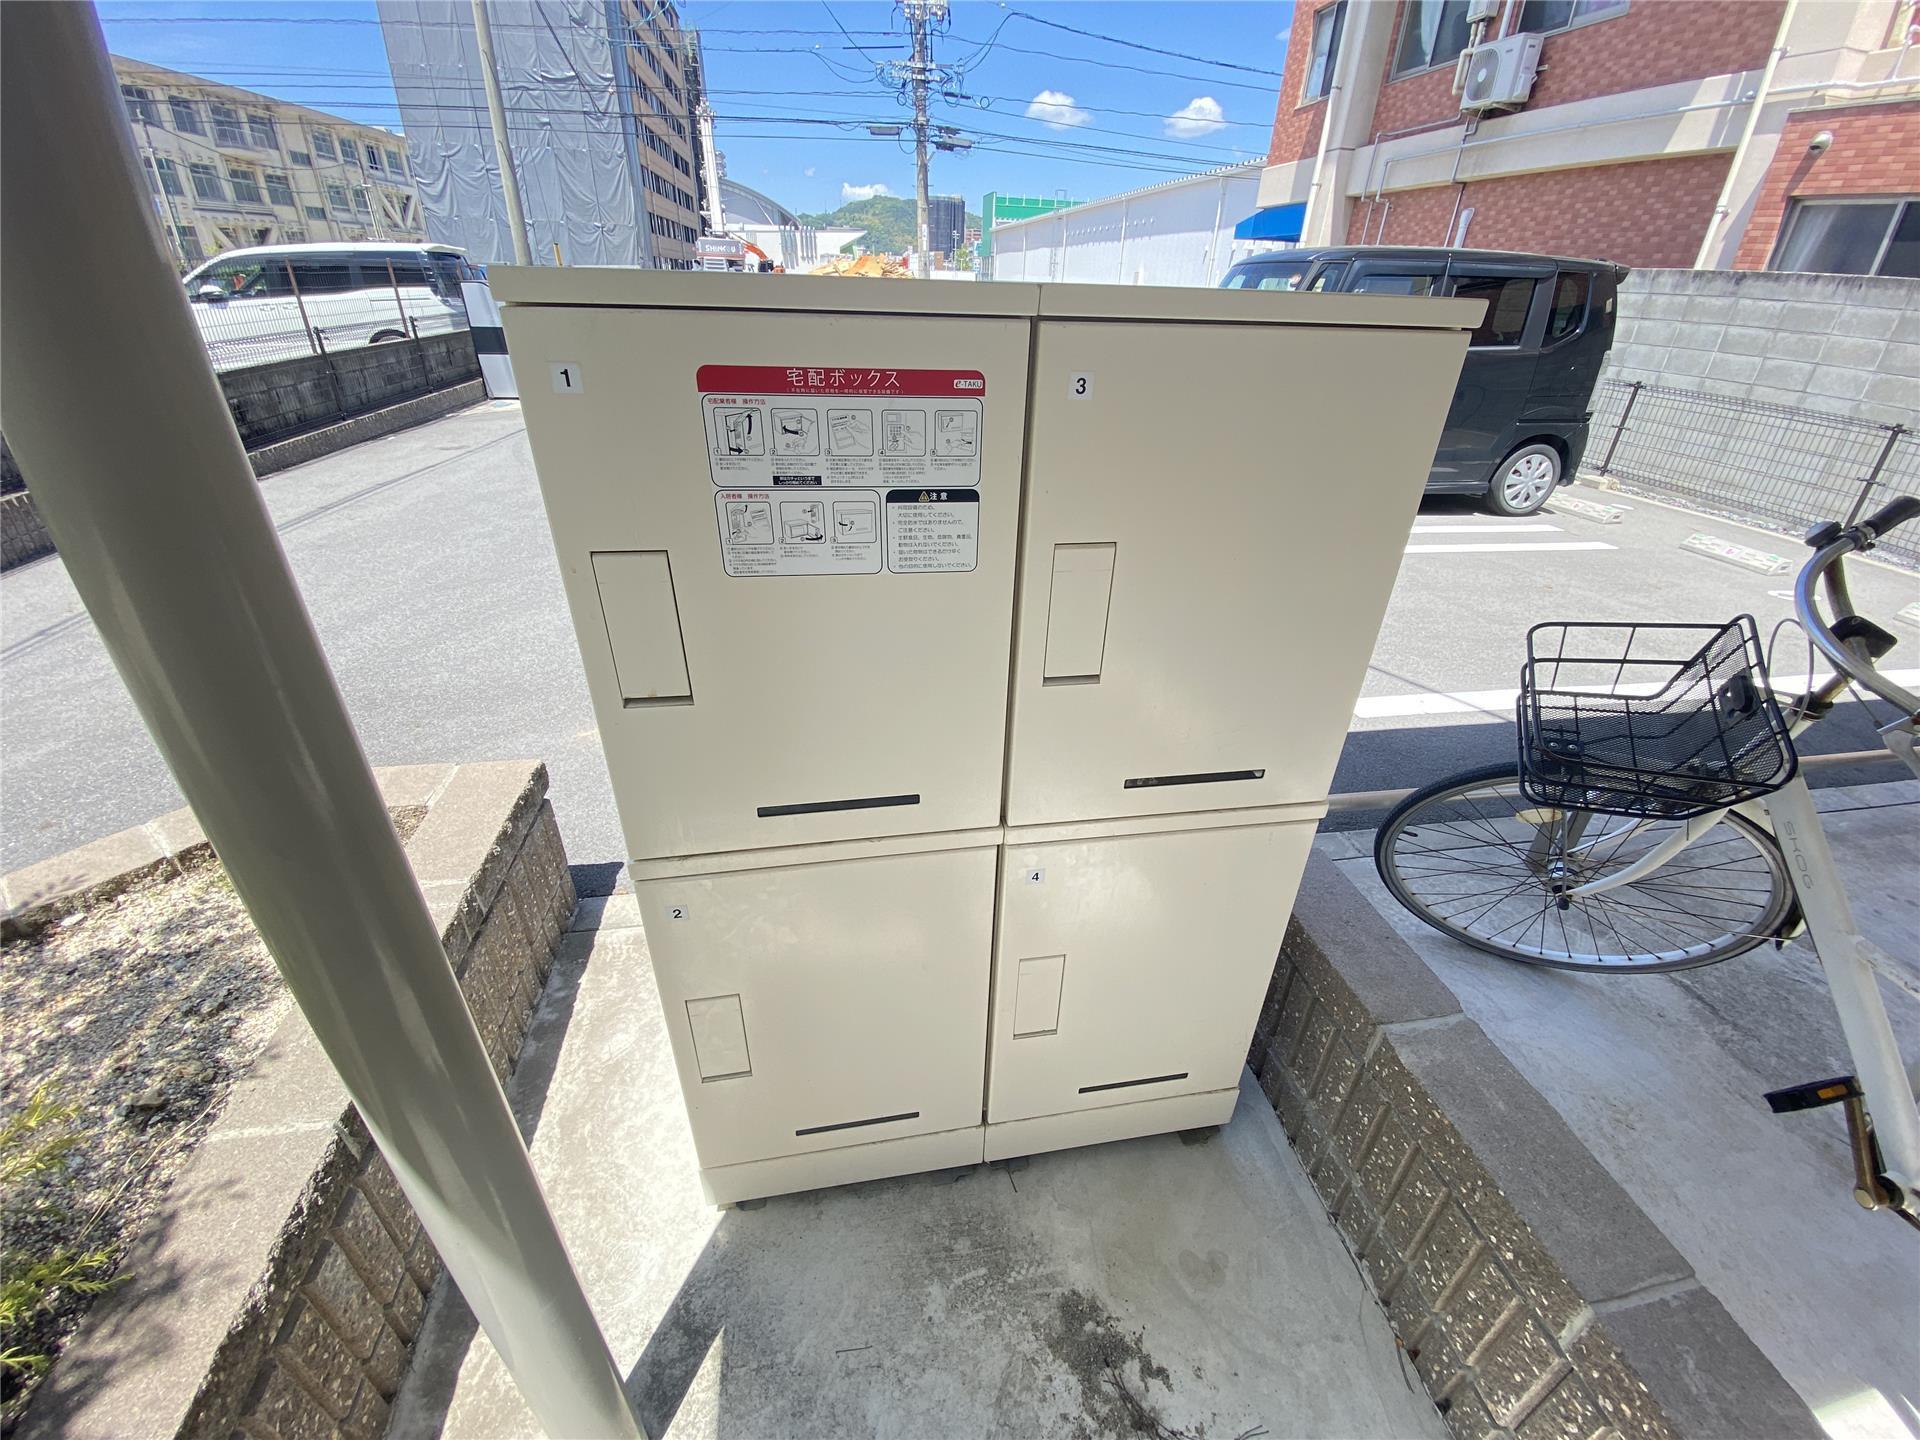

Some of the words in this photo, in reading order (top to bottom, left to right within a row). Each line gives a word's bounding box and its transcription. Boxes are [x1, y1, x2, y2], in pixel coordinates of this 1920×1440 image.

[560, 368, 571, 388] 1
[786, 368, 900, 387] 宅配ボックス
[955, 380, 982, 388] e-TAKU
[1075, 377, 1087, 395] 3
[929, 491, 948, 500] 注意
[1783, 820, 1815, 889] SKOG
[1031, 872, 1040, 881] 4
[672, 908, 683, 919] 2
